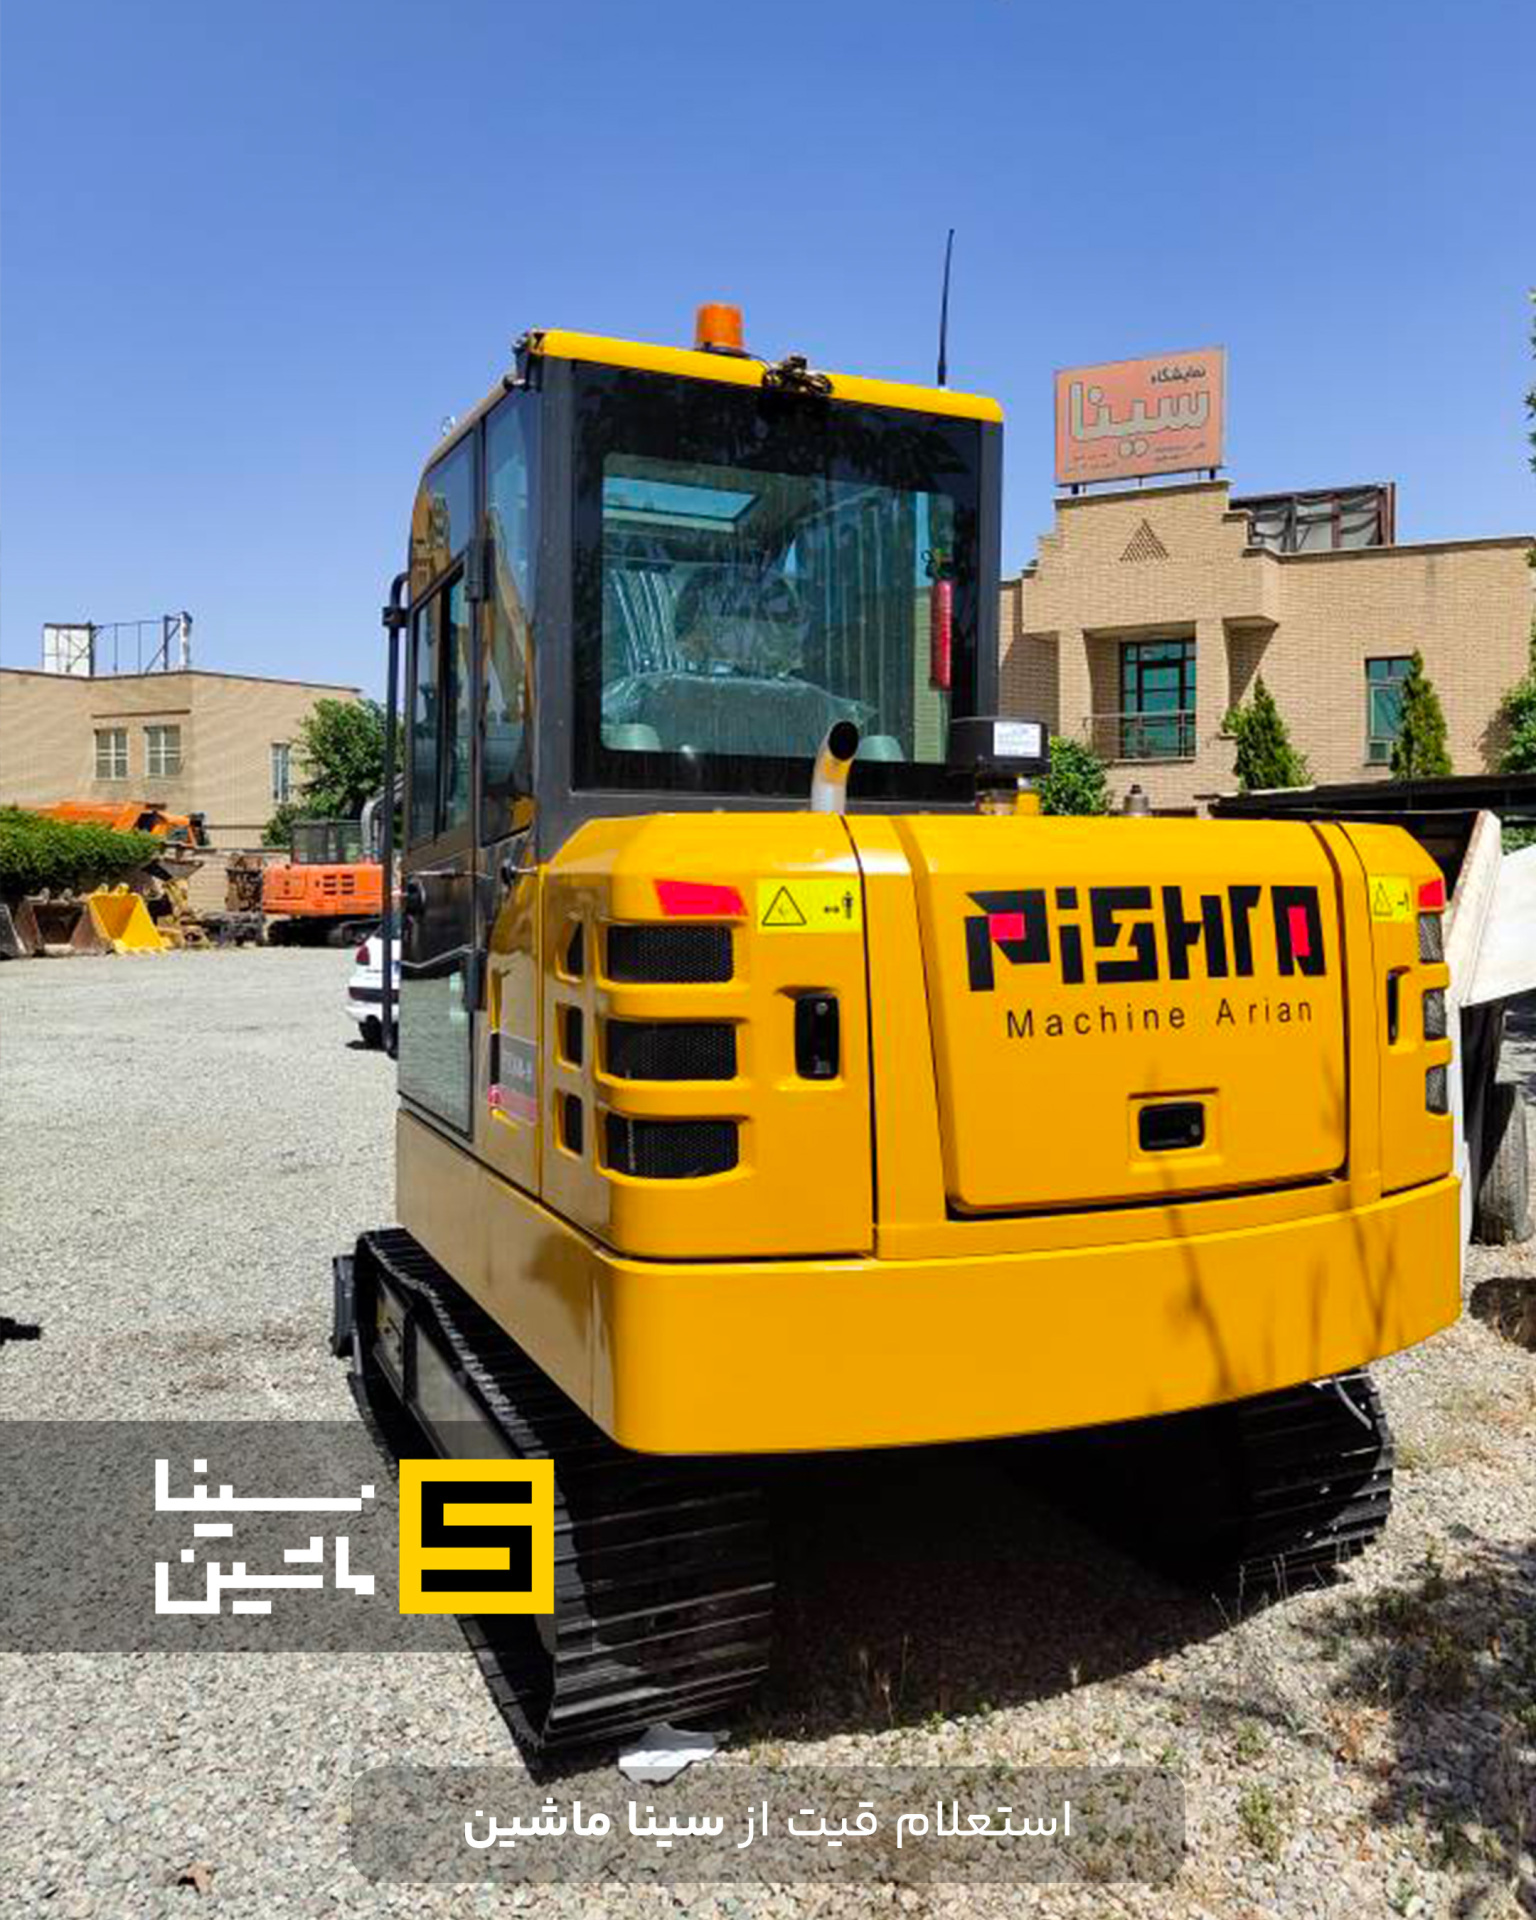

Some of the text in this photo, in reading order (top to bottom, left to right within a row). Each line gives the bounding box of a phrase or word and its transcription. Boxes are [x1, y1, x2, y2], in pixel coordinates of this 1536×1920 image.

[1070, 381, 1211, 459] سینا
[1006, 996, 1313, 1039] Machine Arian
